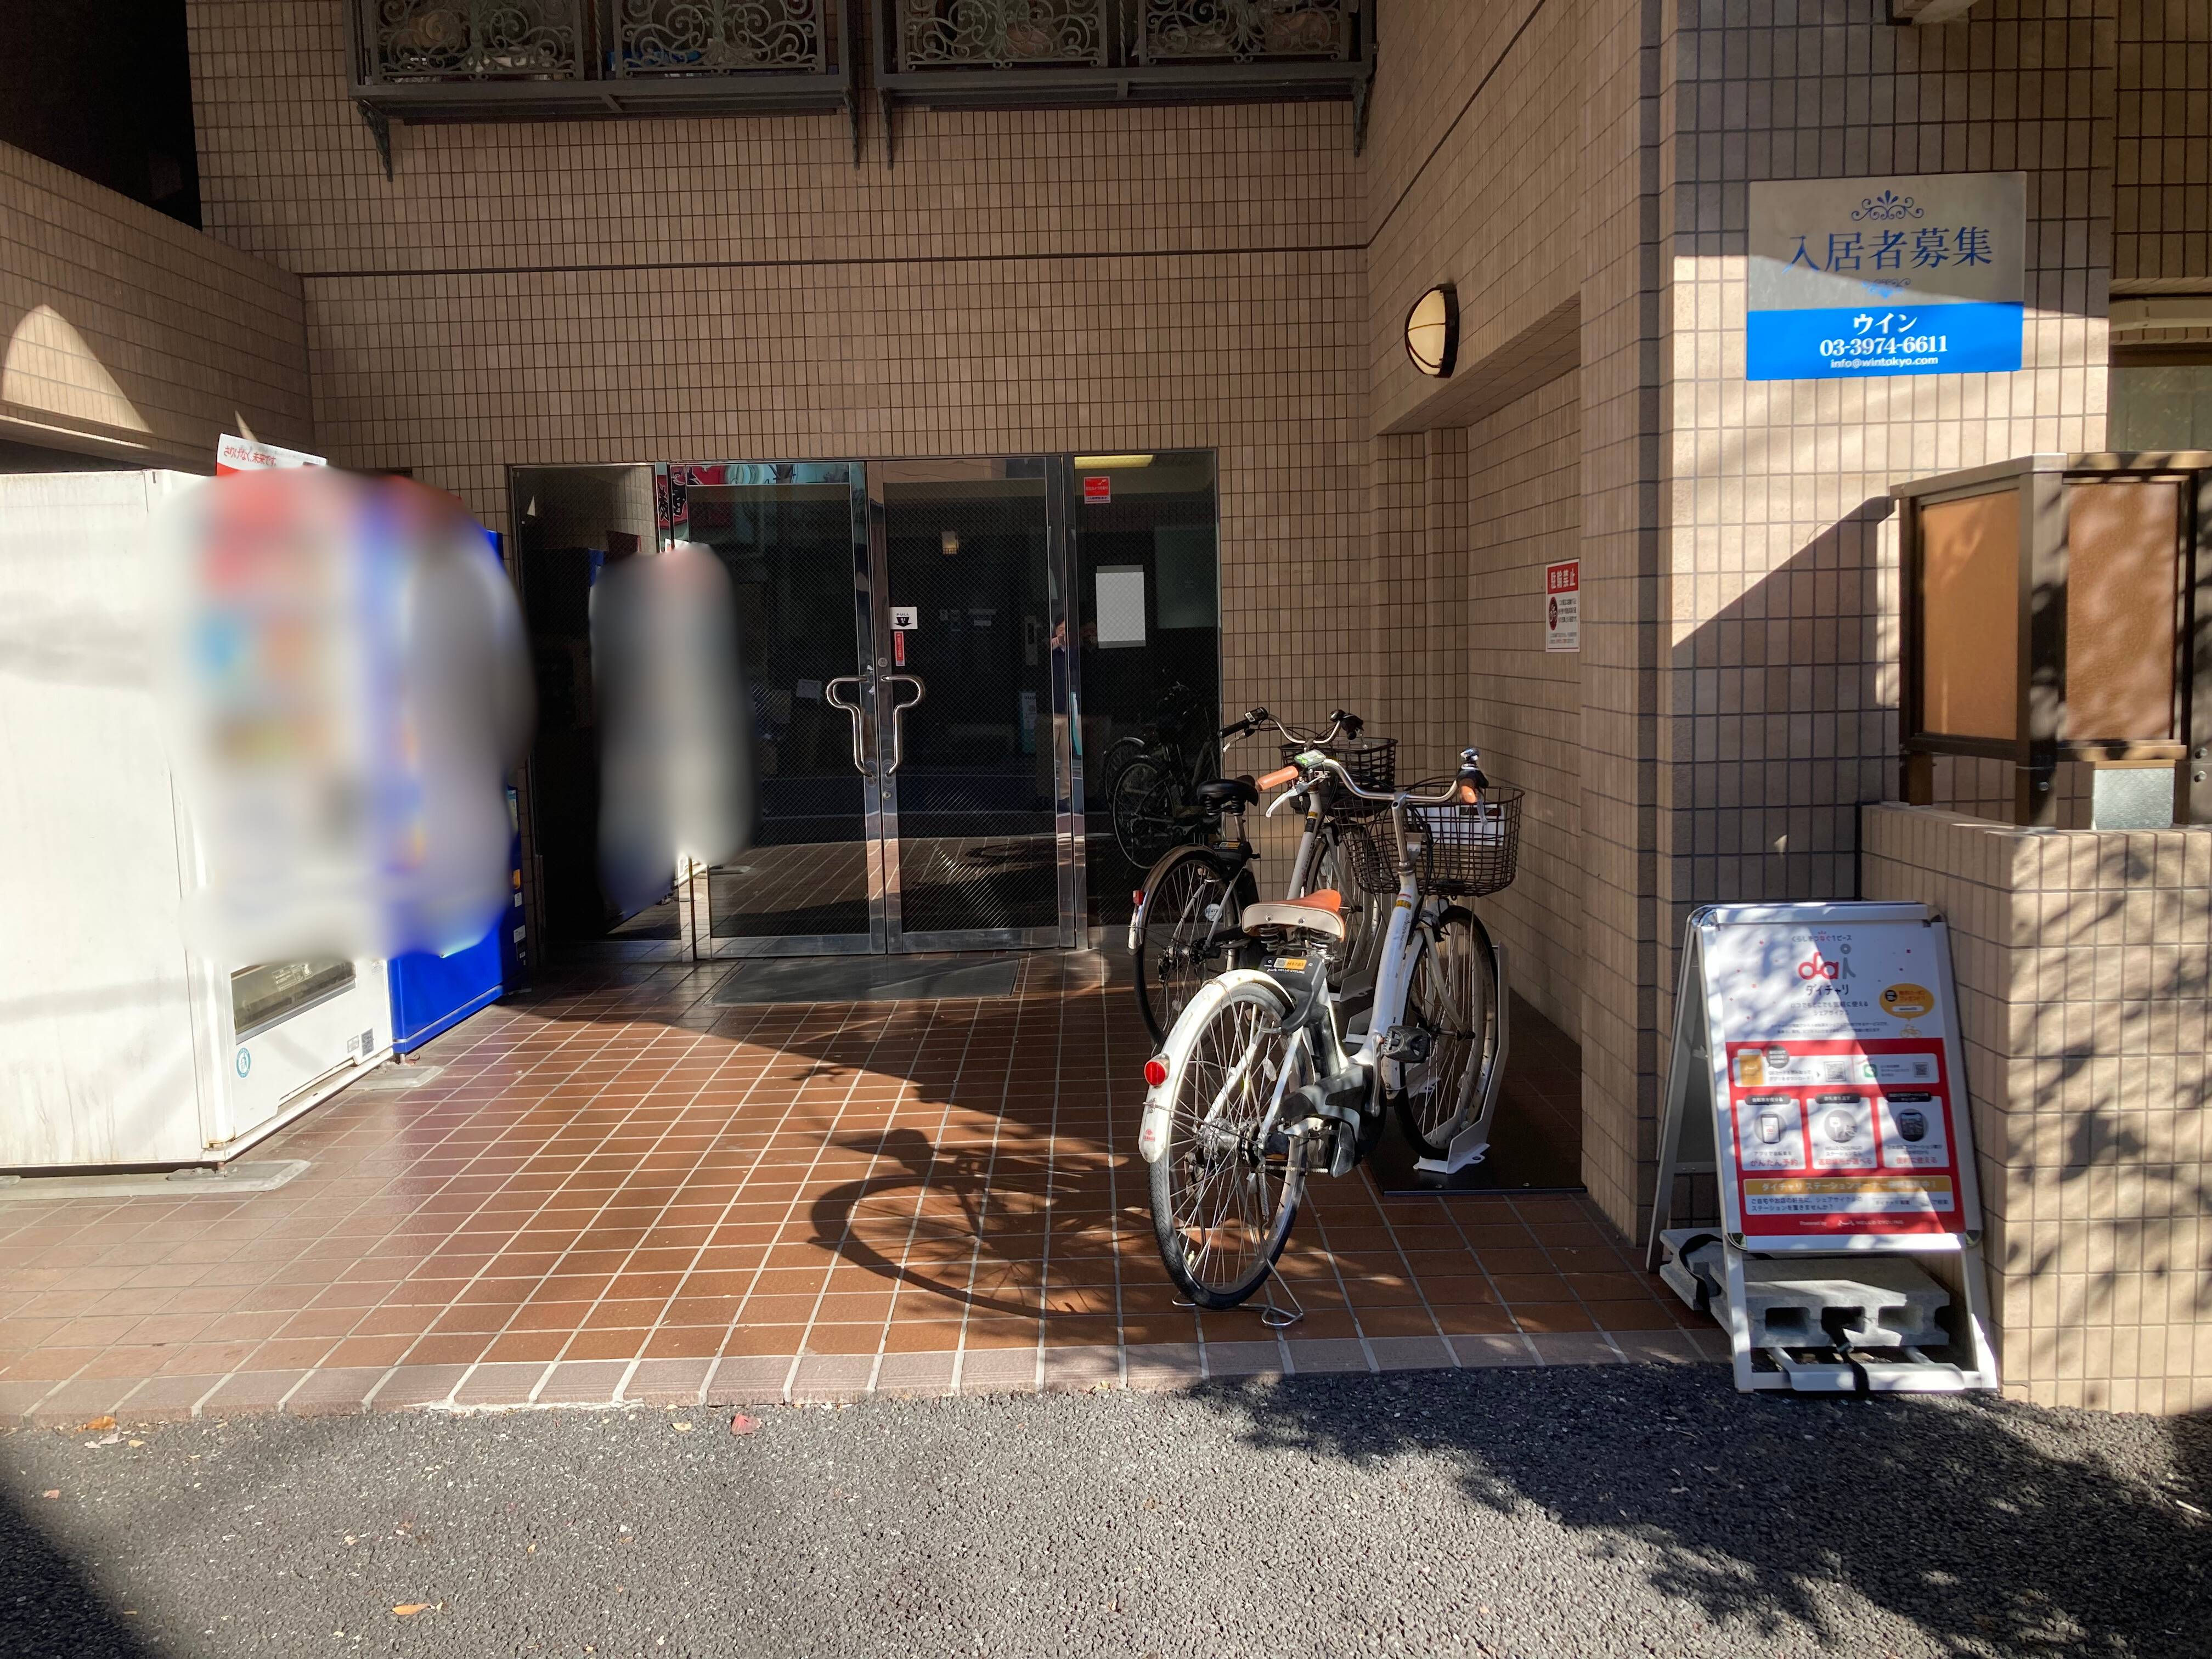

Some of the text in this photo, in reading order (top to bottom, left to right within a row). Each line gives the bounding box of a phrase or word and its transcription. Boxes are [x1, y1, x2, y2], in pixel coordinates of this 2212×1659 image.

[1781, 225, 1993, 274] 入居者募集
[1853, 312, 1918, 335] ウイン
[1819, 335, 1948, 357] 03-3974-6611
[1830, 356, 1939, 369] info@wintokyo.com
[1798, 943, 1857, 980] dai
[1805, 984, 1849, 996] ダイチャリ
